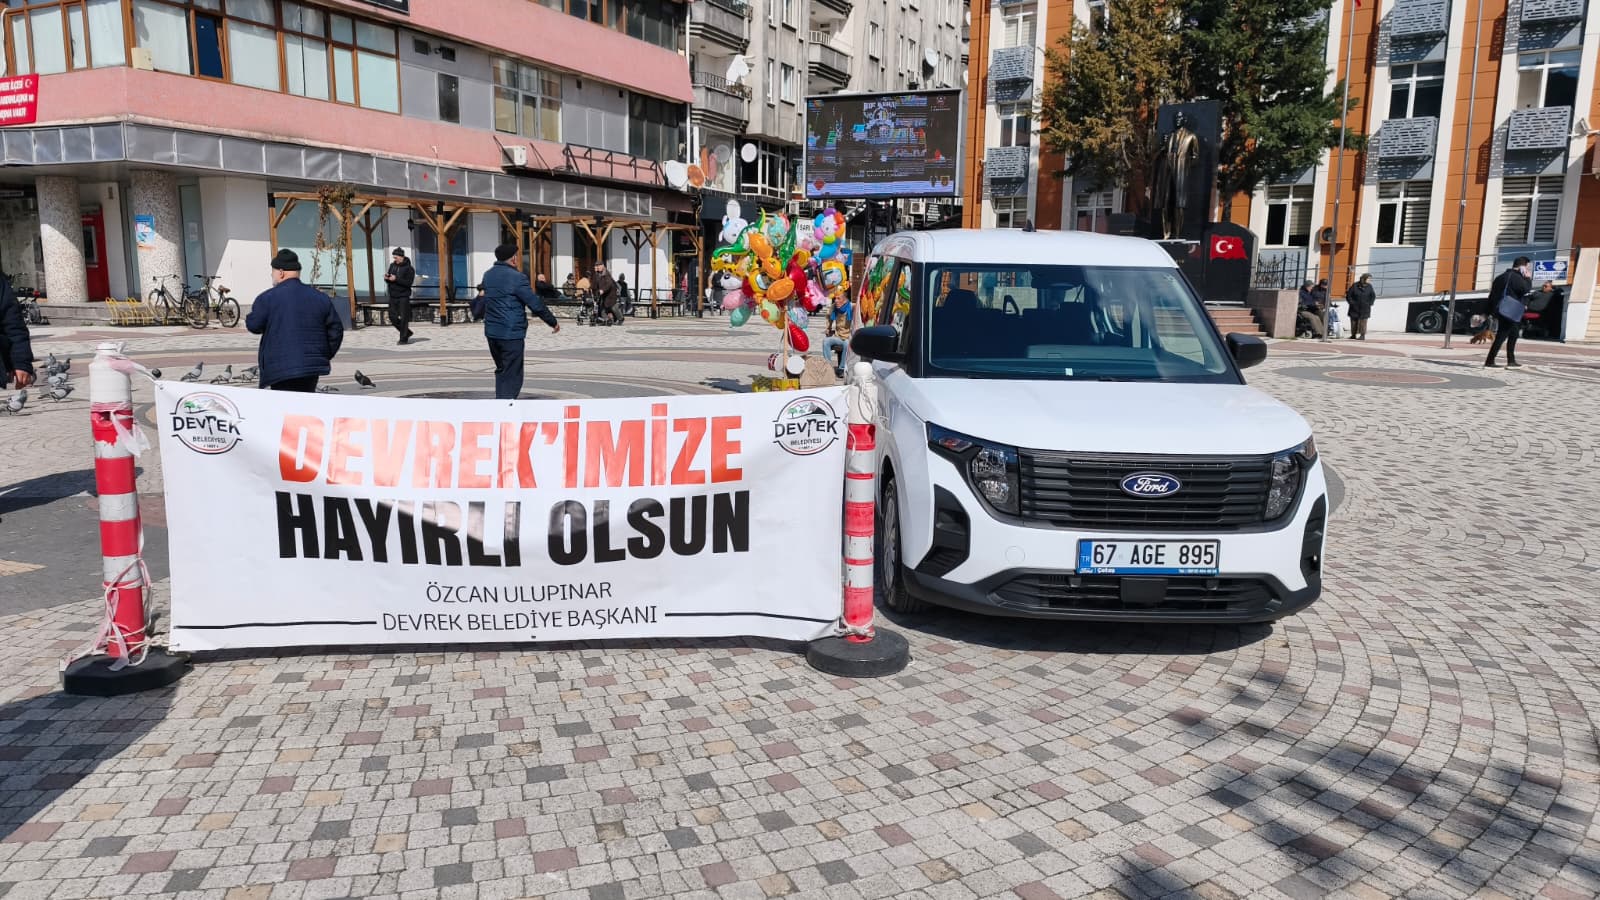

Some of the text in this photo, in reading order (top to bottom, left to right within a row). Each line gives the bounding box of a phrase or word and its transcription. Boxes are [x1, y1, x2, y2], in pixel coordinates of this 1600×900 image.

[279, 403, 743, 489] DEVREK'İMİZE
[1133, 477, 1170, 492] Ford
[275, 490, 750, 567] HAYIRLI OLSUN
[1093, 544, 1215, 565] 67 AGE 895
[426, 581, 612, 603] ÖZCAN ULUPINAR
[383, 605, 657, 631] DEVREK BELEDİYE BAŞKANI
